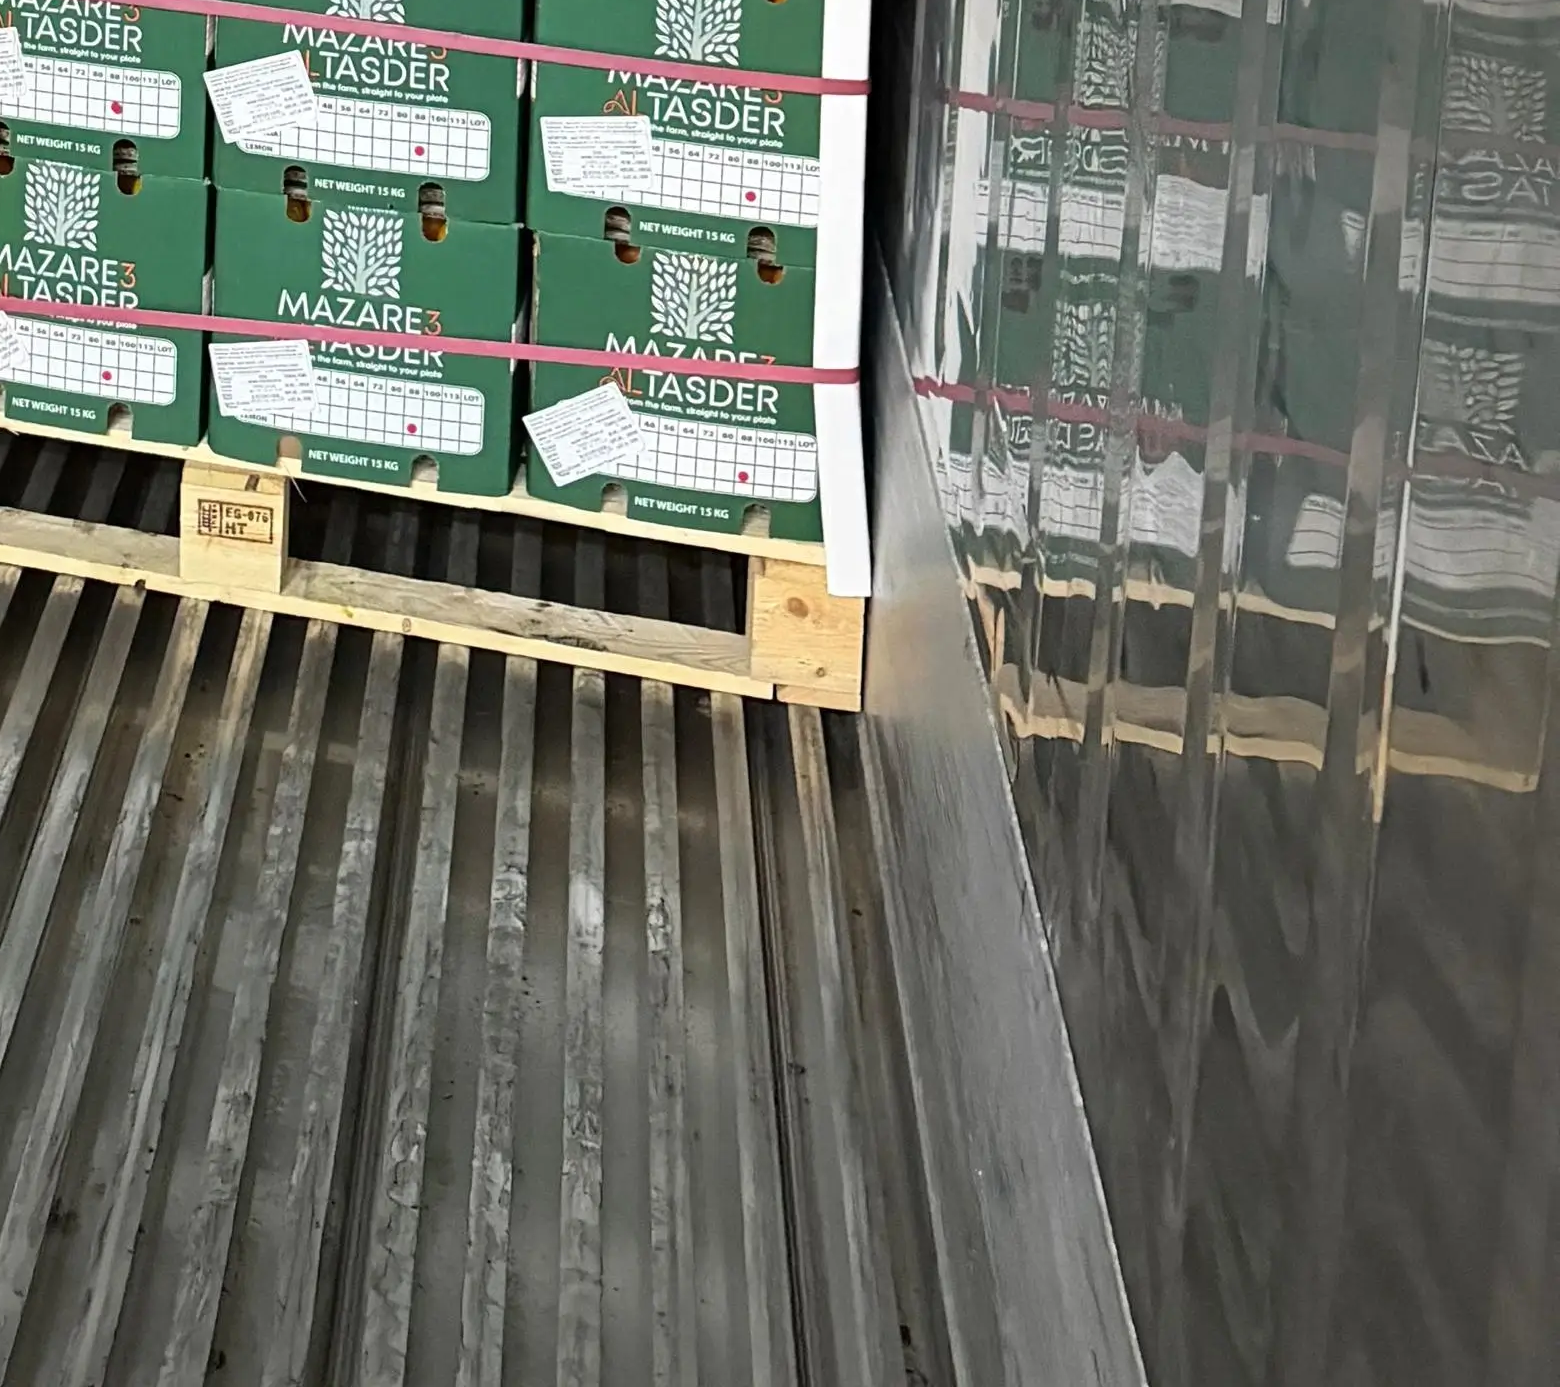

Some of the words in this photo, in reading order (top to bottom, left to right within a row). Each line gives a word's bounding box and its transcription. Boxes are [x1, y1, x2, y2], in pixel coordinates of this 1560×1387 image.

[17, 135, 35, 147] NET
[36, 137, 72, 151] WEIGHT
[75, 142, 86, 153] 15
[87, 143, 101, 154] KG
[277, 289, 441, 335] MAZARE3
[635, 496, 655, 509] NET
[657, 499, 697, 515] WEIGHT
[700, 505, 712, 517] 15
[714, 507, 729, 519] KG
[225, 523, 247, 535] HT
